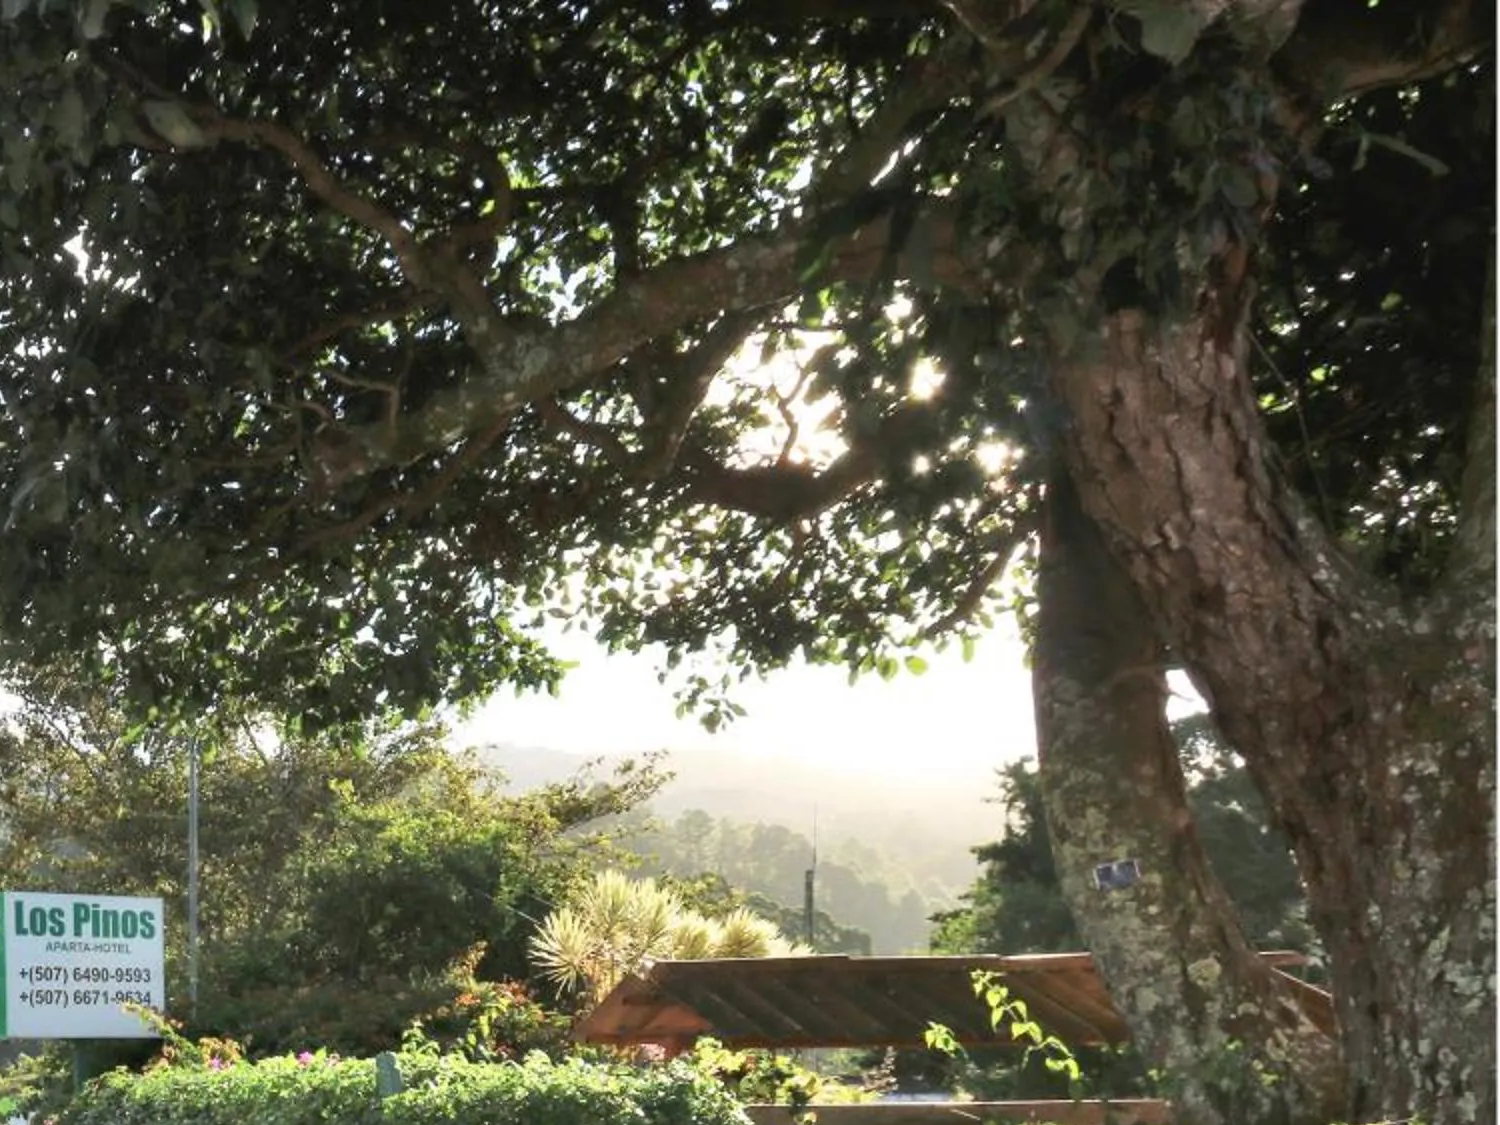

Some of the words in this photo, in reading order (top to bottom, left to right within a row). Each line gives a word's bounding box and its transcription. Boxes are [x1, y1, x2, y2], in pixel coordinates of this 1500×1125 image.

[14, 900, 65, 936] Los
[73, 902, 155, 939] Pinos
[45, 941, 131, 954] APARTA-HOTEL
[19, 966, 68, 985] +(507)
[73, 967, 151, 983] 6490-9593
[19, 989, 68, 1008] +(507)
